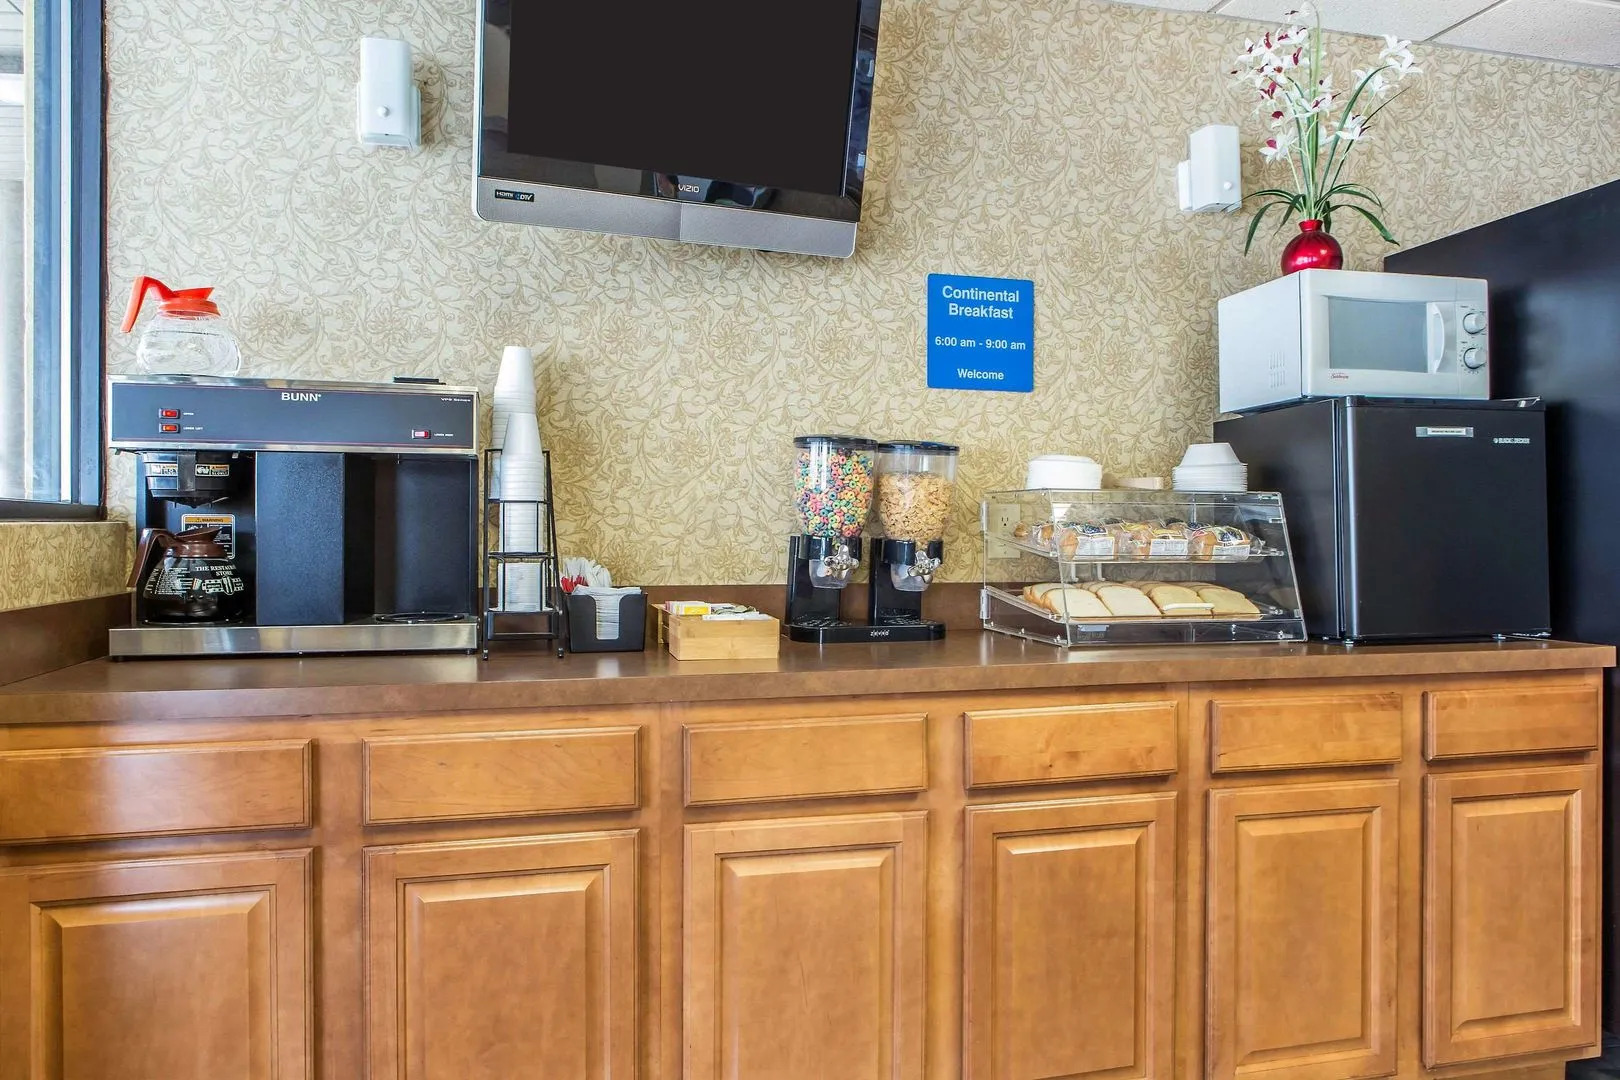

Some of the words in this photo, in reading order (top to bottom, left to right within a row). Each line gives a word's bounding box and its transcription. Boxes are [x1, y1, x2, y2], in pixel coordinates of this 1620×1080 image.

[678, 184, 700, 193] VIZIO
[942, 285, 1020, 303] Continental
[948, 303, 1014, 319] Breakfast
[935, 336, 957, 346] 6:00
[960, 339, 976, 347] am
[985, 339, 1008, 349] 9:00
[1010, 341, 1026, 350] am
[957, 369, 1004, 380] Welcome
[281, 392, 318, 401] BUNN
